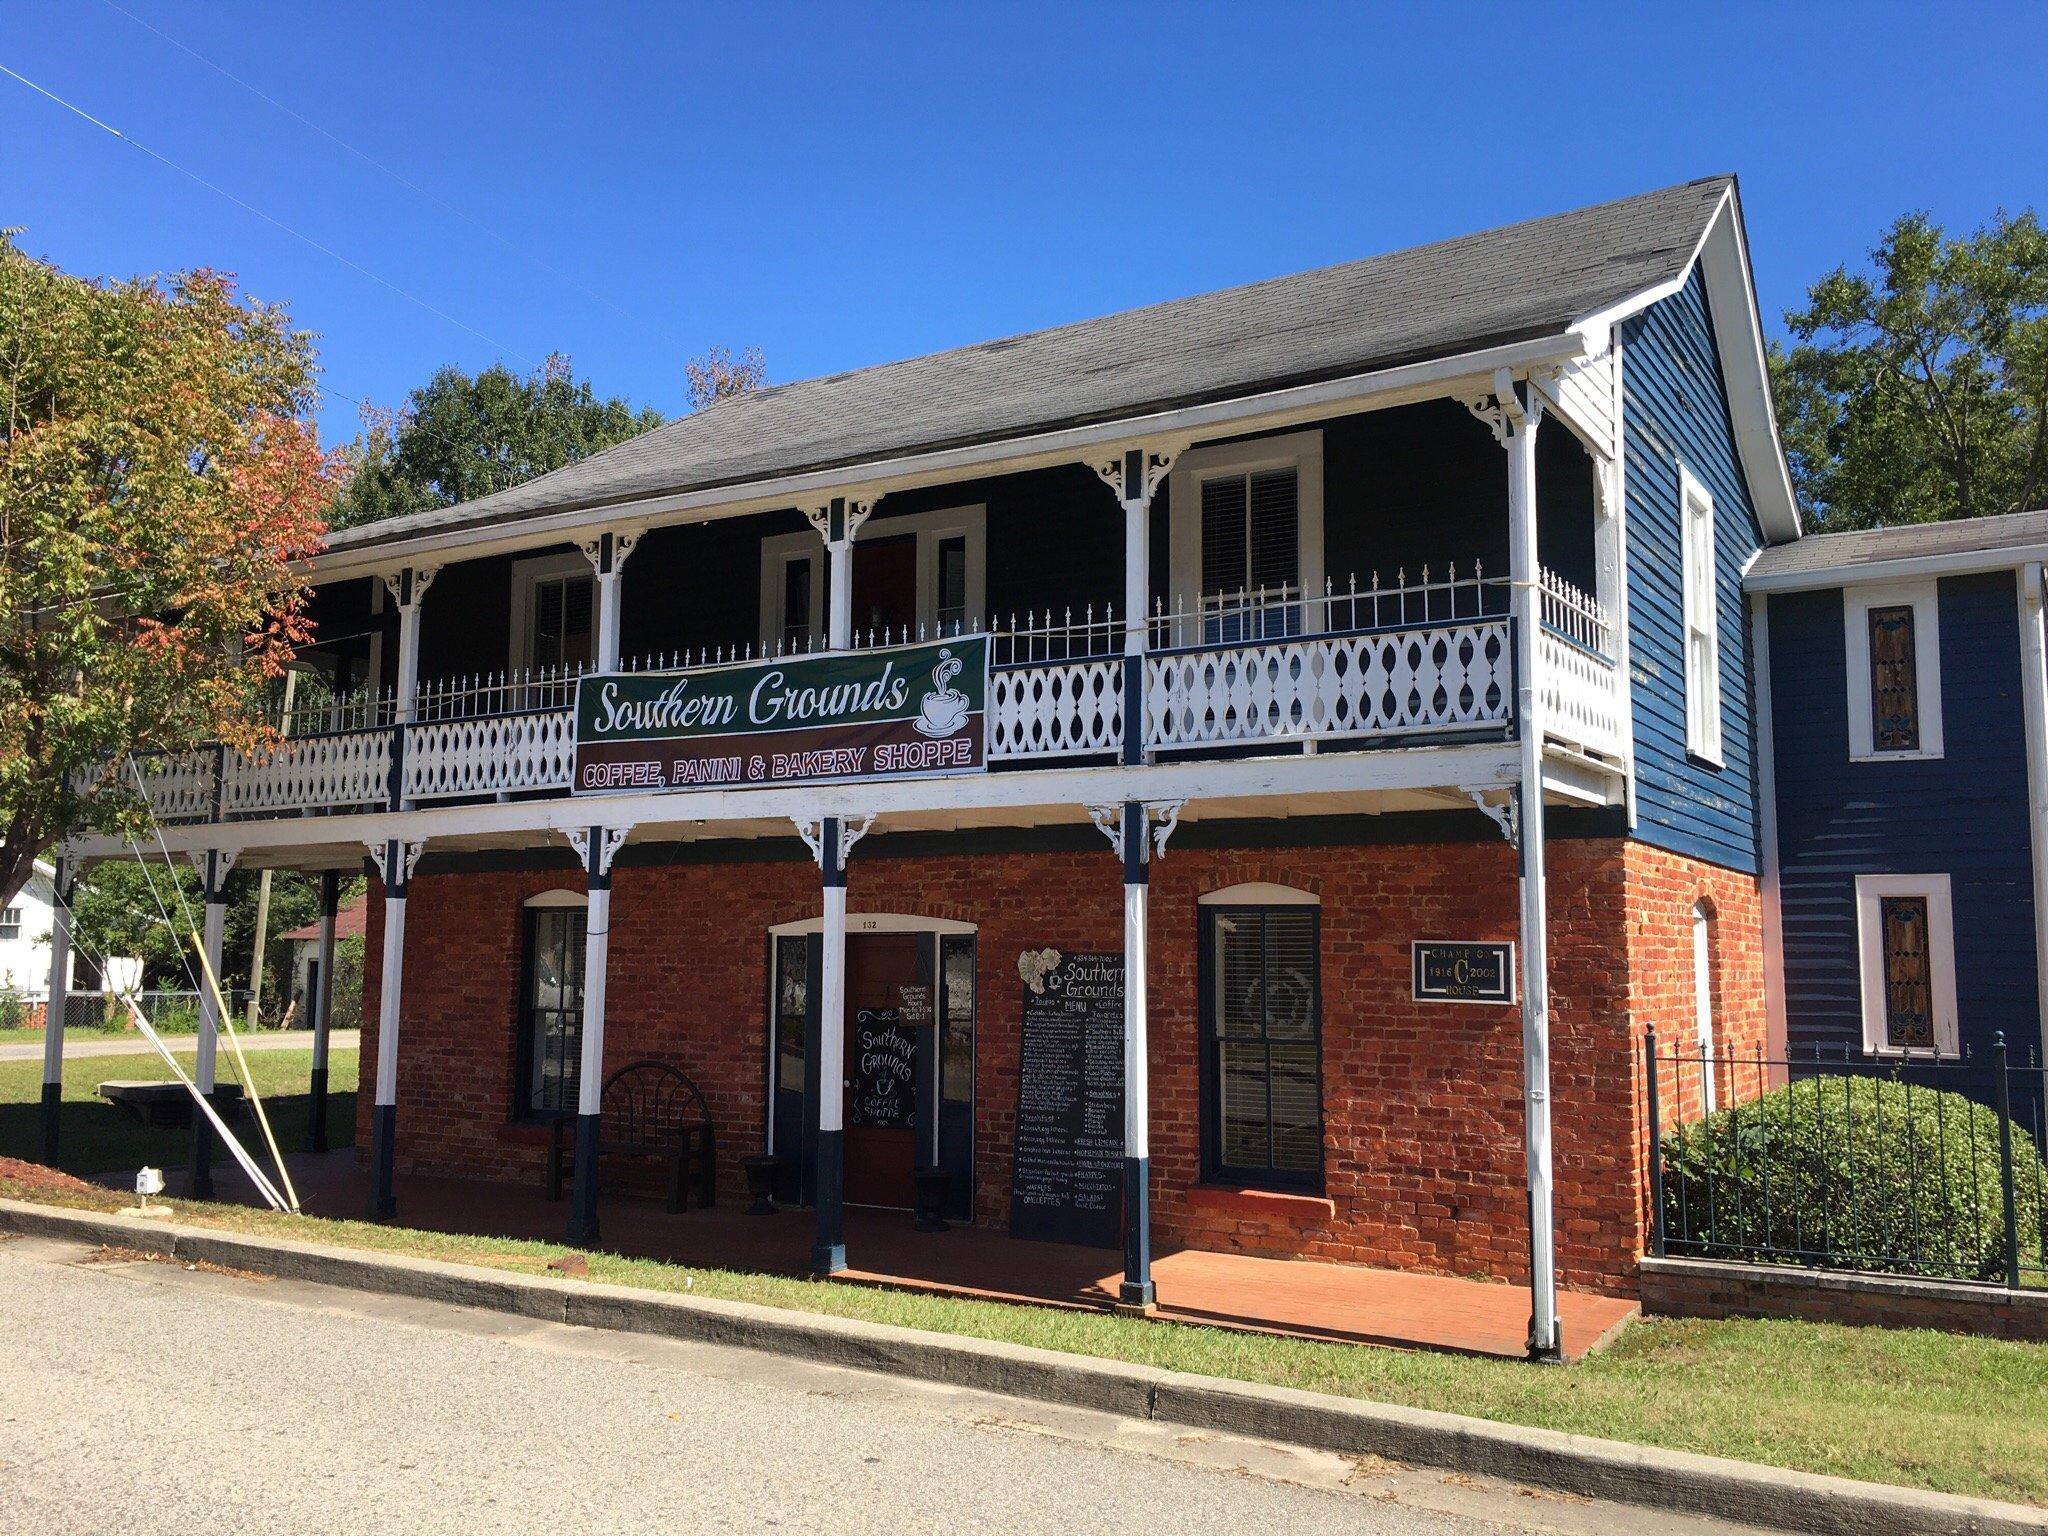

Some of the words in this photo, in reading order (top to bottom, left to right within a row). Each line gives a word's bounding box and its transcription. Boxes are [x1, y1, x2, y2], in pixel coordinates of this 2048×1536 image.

[594, 678, 738, 733] Southern
[749, 661, 910, 725] Grounds
[583, 761, 665, 788] COFFEE,
[673, 755, 741, 784] PANINI
[748, 755, 765, 780] &
[772, 747, 867, 778] BAKERY
[874, 738, 972, 772] SHOPPE
[863, 921, 877, 929] 132
[1431, 948, 1491, 959] CHAMPON
[1430, 967, 1452, 977] 1916
[1454, 959, 1469, 984] C
[1470, 968, 1496, 978] 2002
[1066, 981, 1124, 997] Grounds
[1446, 985, 1479, 995] HOUSE
[1065, 1001, 1087, 1012] MENU
[864, 1097, 900, 1107] COFFEE
[864, 1107, 900, 1118] SHOPPE
